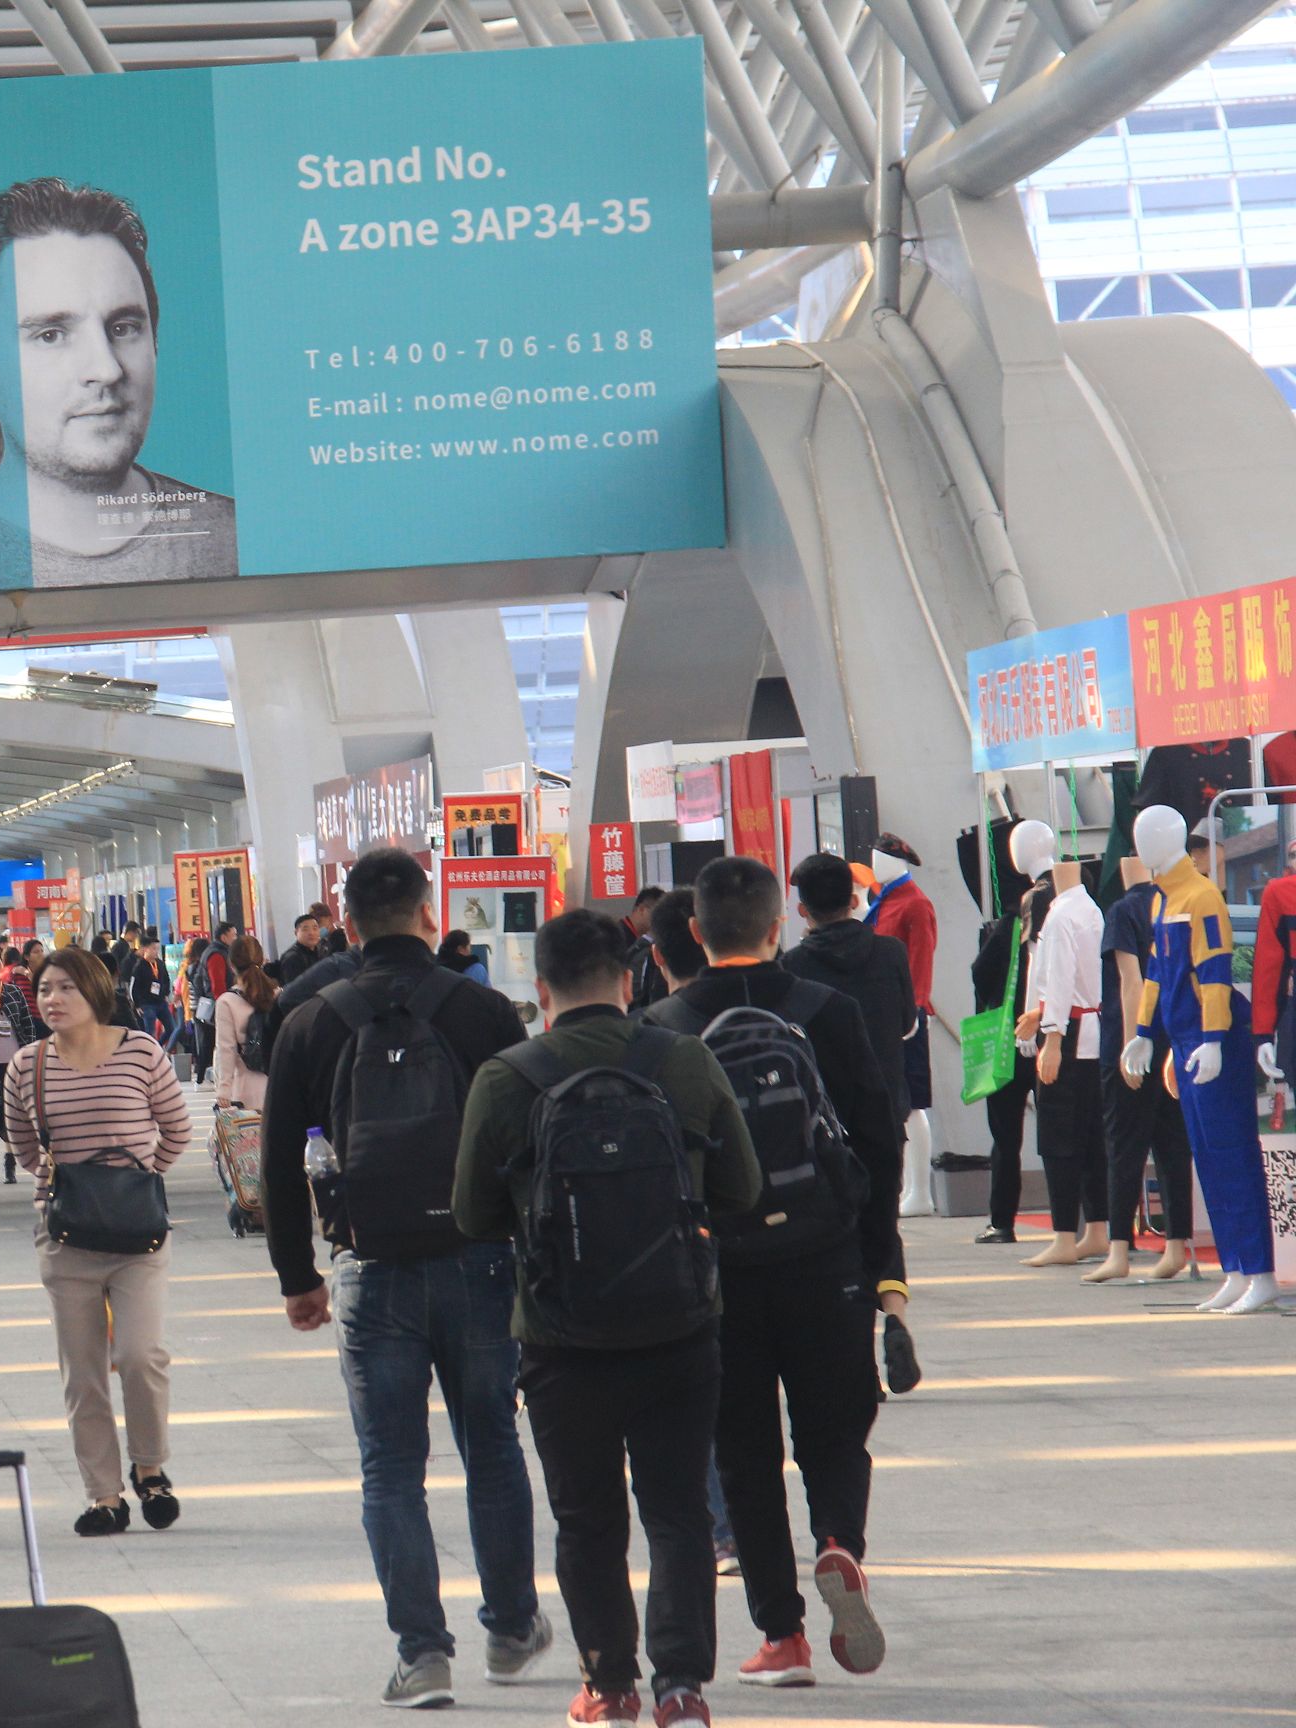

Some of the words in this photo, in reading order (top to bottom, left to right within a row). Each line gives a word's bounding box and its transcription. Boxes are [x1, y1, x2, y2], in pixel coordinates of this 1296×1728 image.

[297, 146, 422, 190] Stand
[435, 146, 506, 181] No.
[299, 218, 328, 253] A
[338, 217, 439, 252] zone
[450, 198, 652, 244] 3AP34-35
[414, 379, 657, 410] nome@nome.com
[309, 440, 422, 465] Website:
[431, 426, 659, 457] www.nome.com
[97, 493, 137, 506] Rikard
[141, 490, 206, 503] Söderberg
